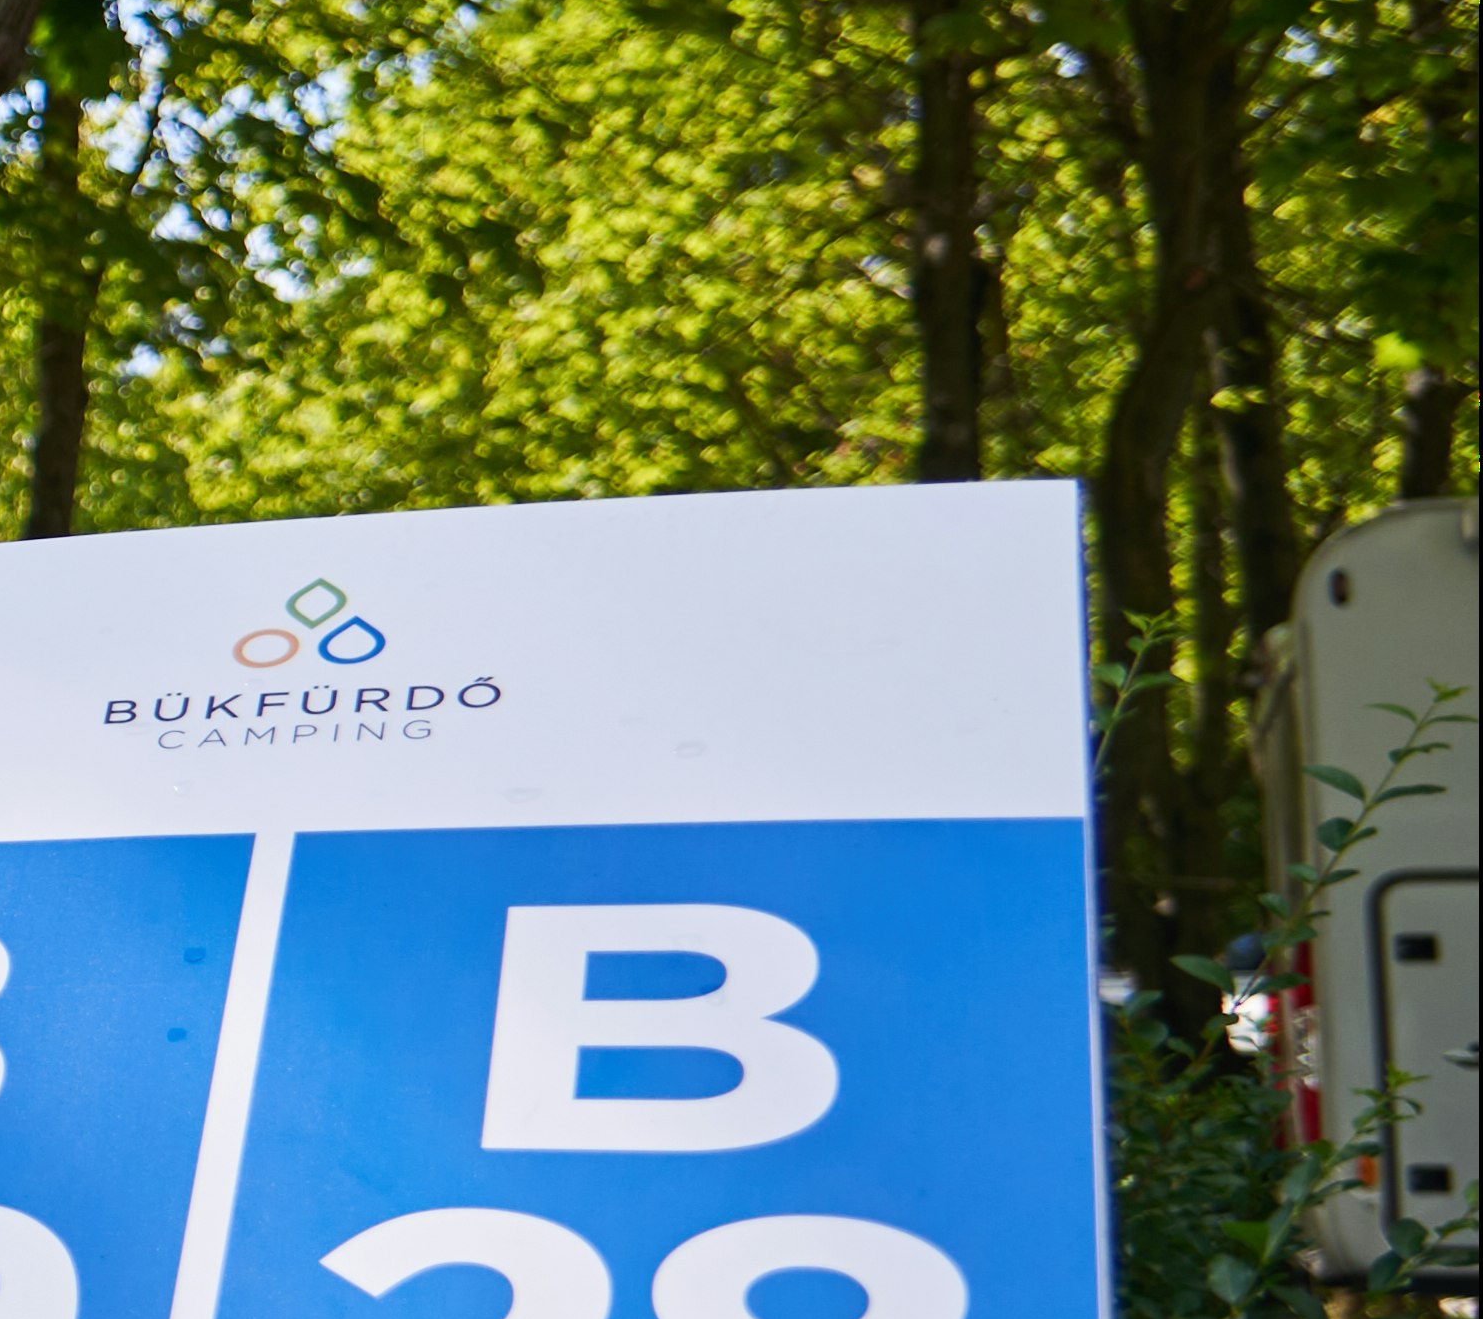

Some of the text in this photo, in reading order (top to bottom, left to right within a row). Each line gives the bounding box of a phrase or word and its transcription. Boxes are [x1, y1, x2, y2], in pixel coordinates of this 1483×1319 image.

[103, 676, 502, 725] BÜKFÜRDŐ
[157, 719, 433, 750] CAMPING
[481, 903, 838, 1152] B
